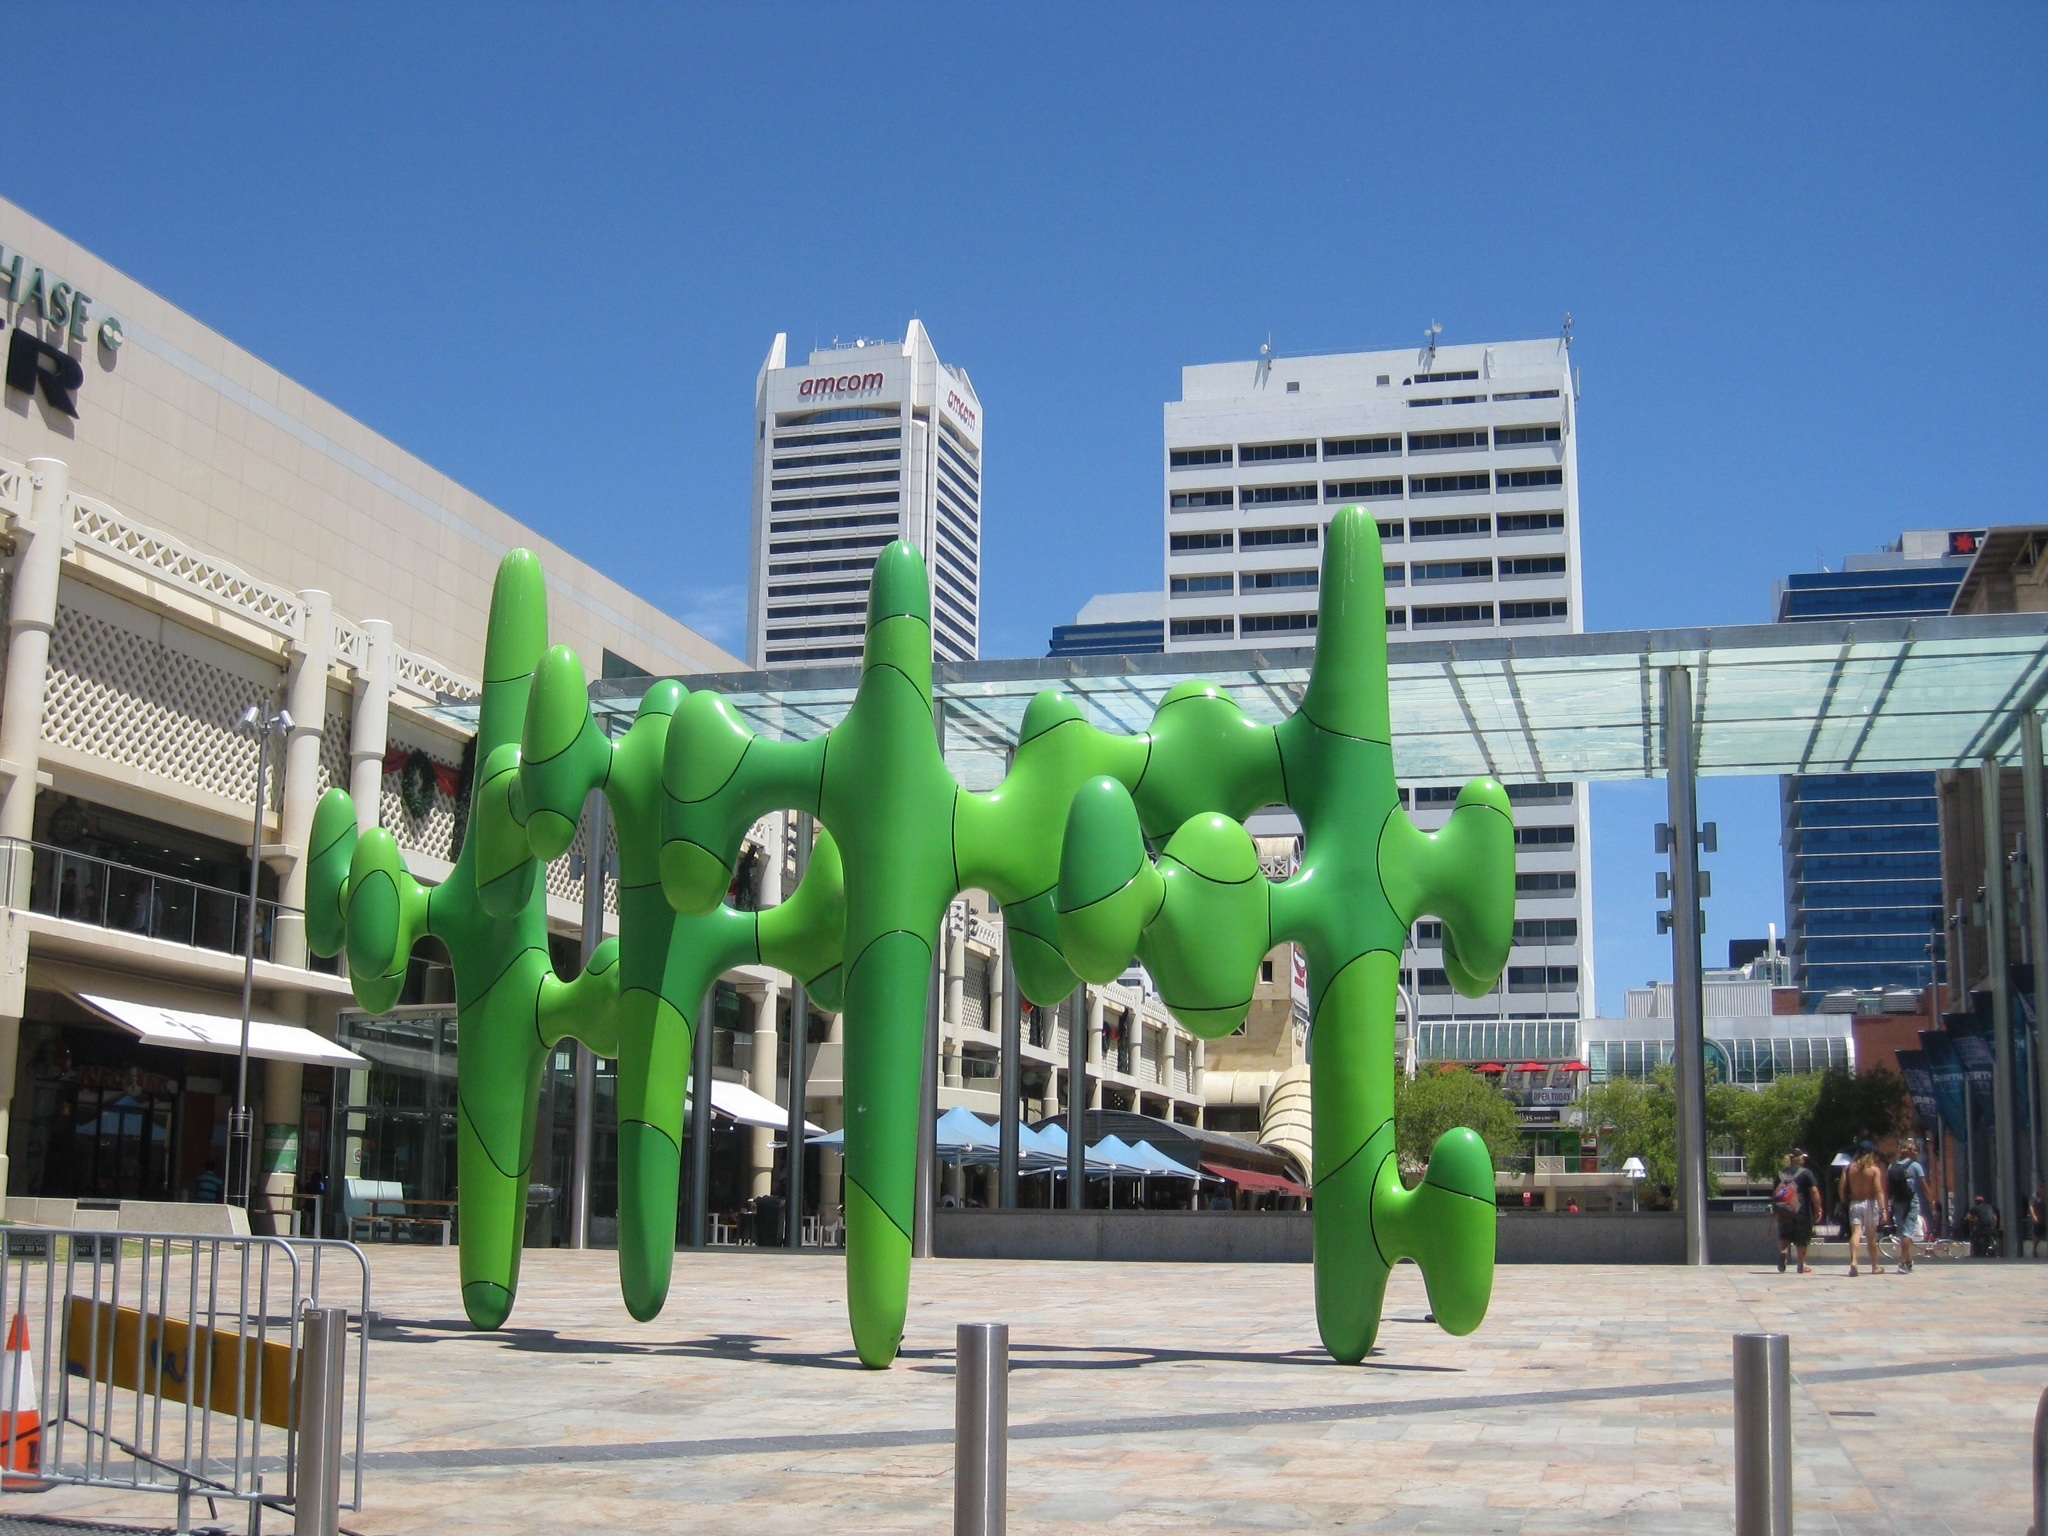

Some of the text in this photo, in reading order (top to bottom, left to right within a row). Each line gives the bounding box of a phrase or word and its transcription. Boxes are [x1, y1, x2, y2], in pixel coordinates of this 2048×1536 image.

[0, 317, 85, 420] R
[799, 372, 884, 396] amcom
[947, 390, 976, 431] amcom
[1534, 1092, 1571, 1101] OPEN TODAY
